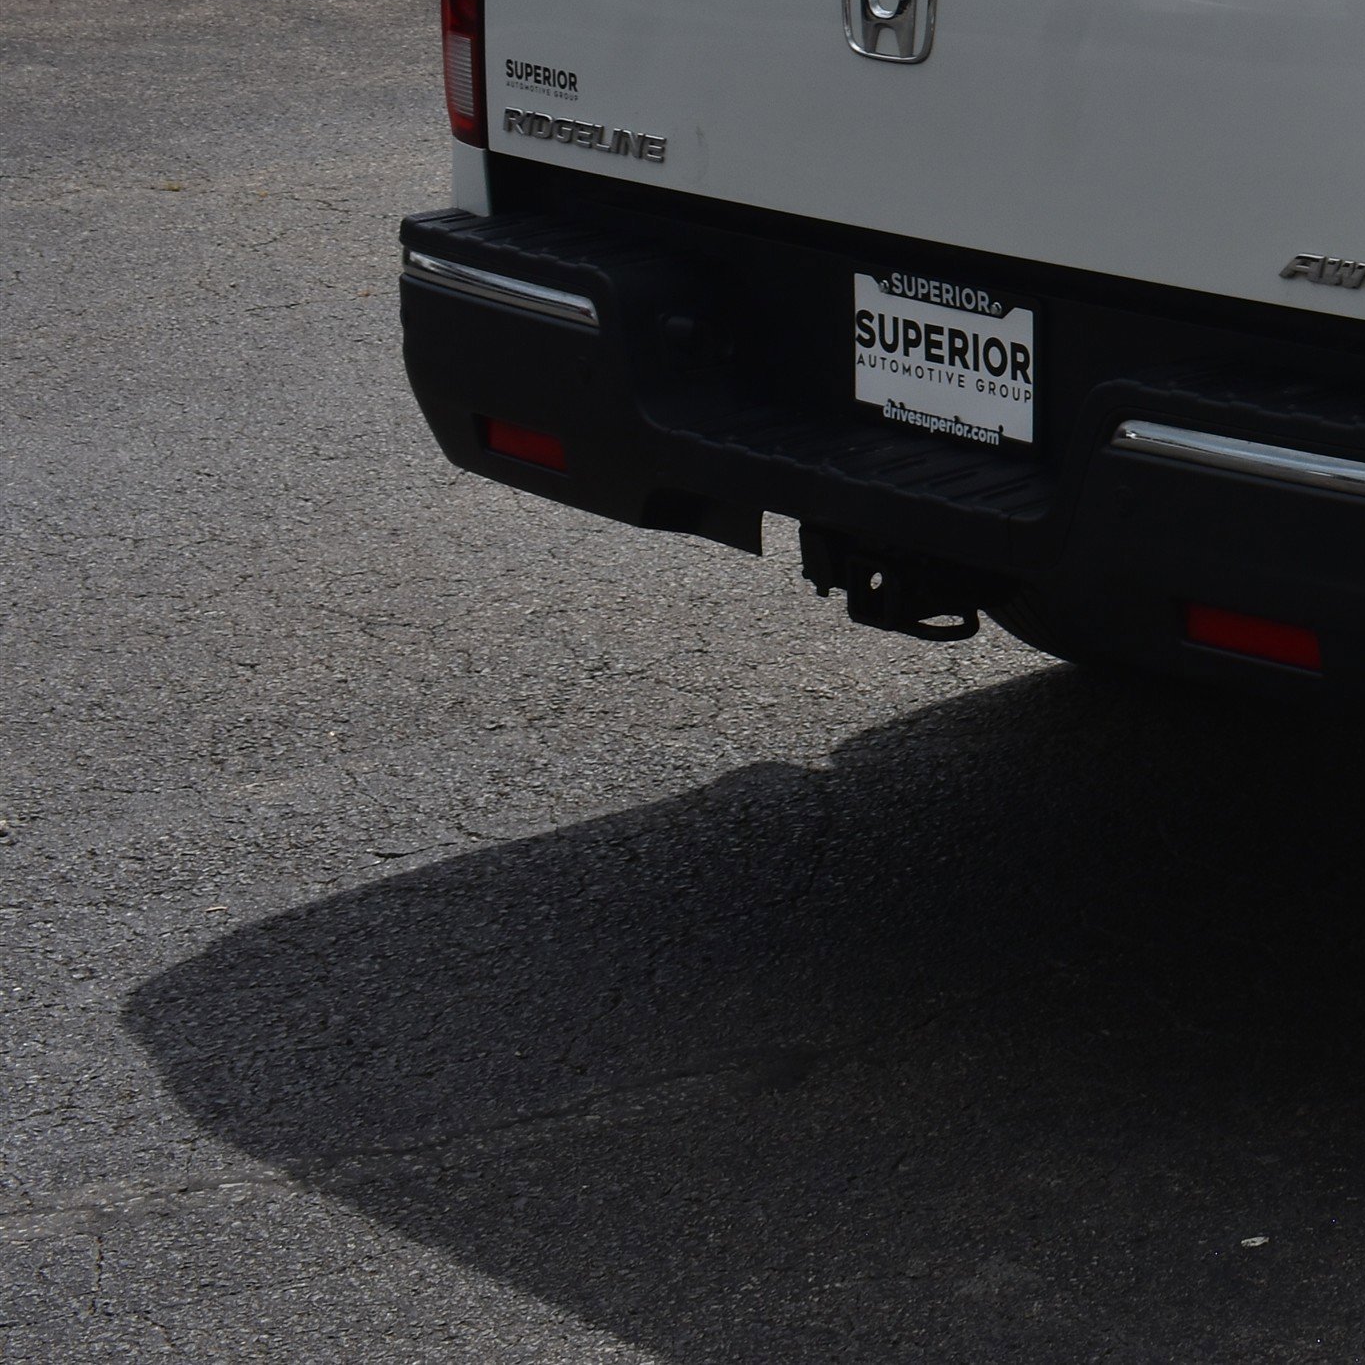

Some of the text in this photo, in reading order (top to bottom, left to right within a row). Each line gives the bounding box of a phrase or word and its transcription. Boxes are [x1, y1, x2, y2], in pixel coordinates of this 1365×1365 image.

[505, 59, 578, 92] SUPERIOR
[506, 82, 579, 101] AUTOMOTIVE GROUP
[503, 106, 667, 163] RIDGELINE
[891, 272, 990, 314] SUPERIOR
[856, 309, 1032, 385] SUPERIOR
[857, 353, 1032, 404] AUTOMOTIVE GROUP
[883, 401, 1000, 446] drivesuperior.com
